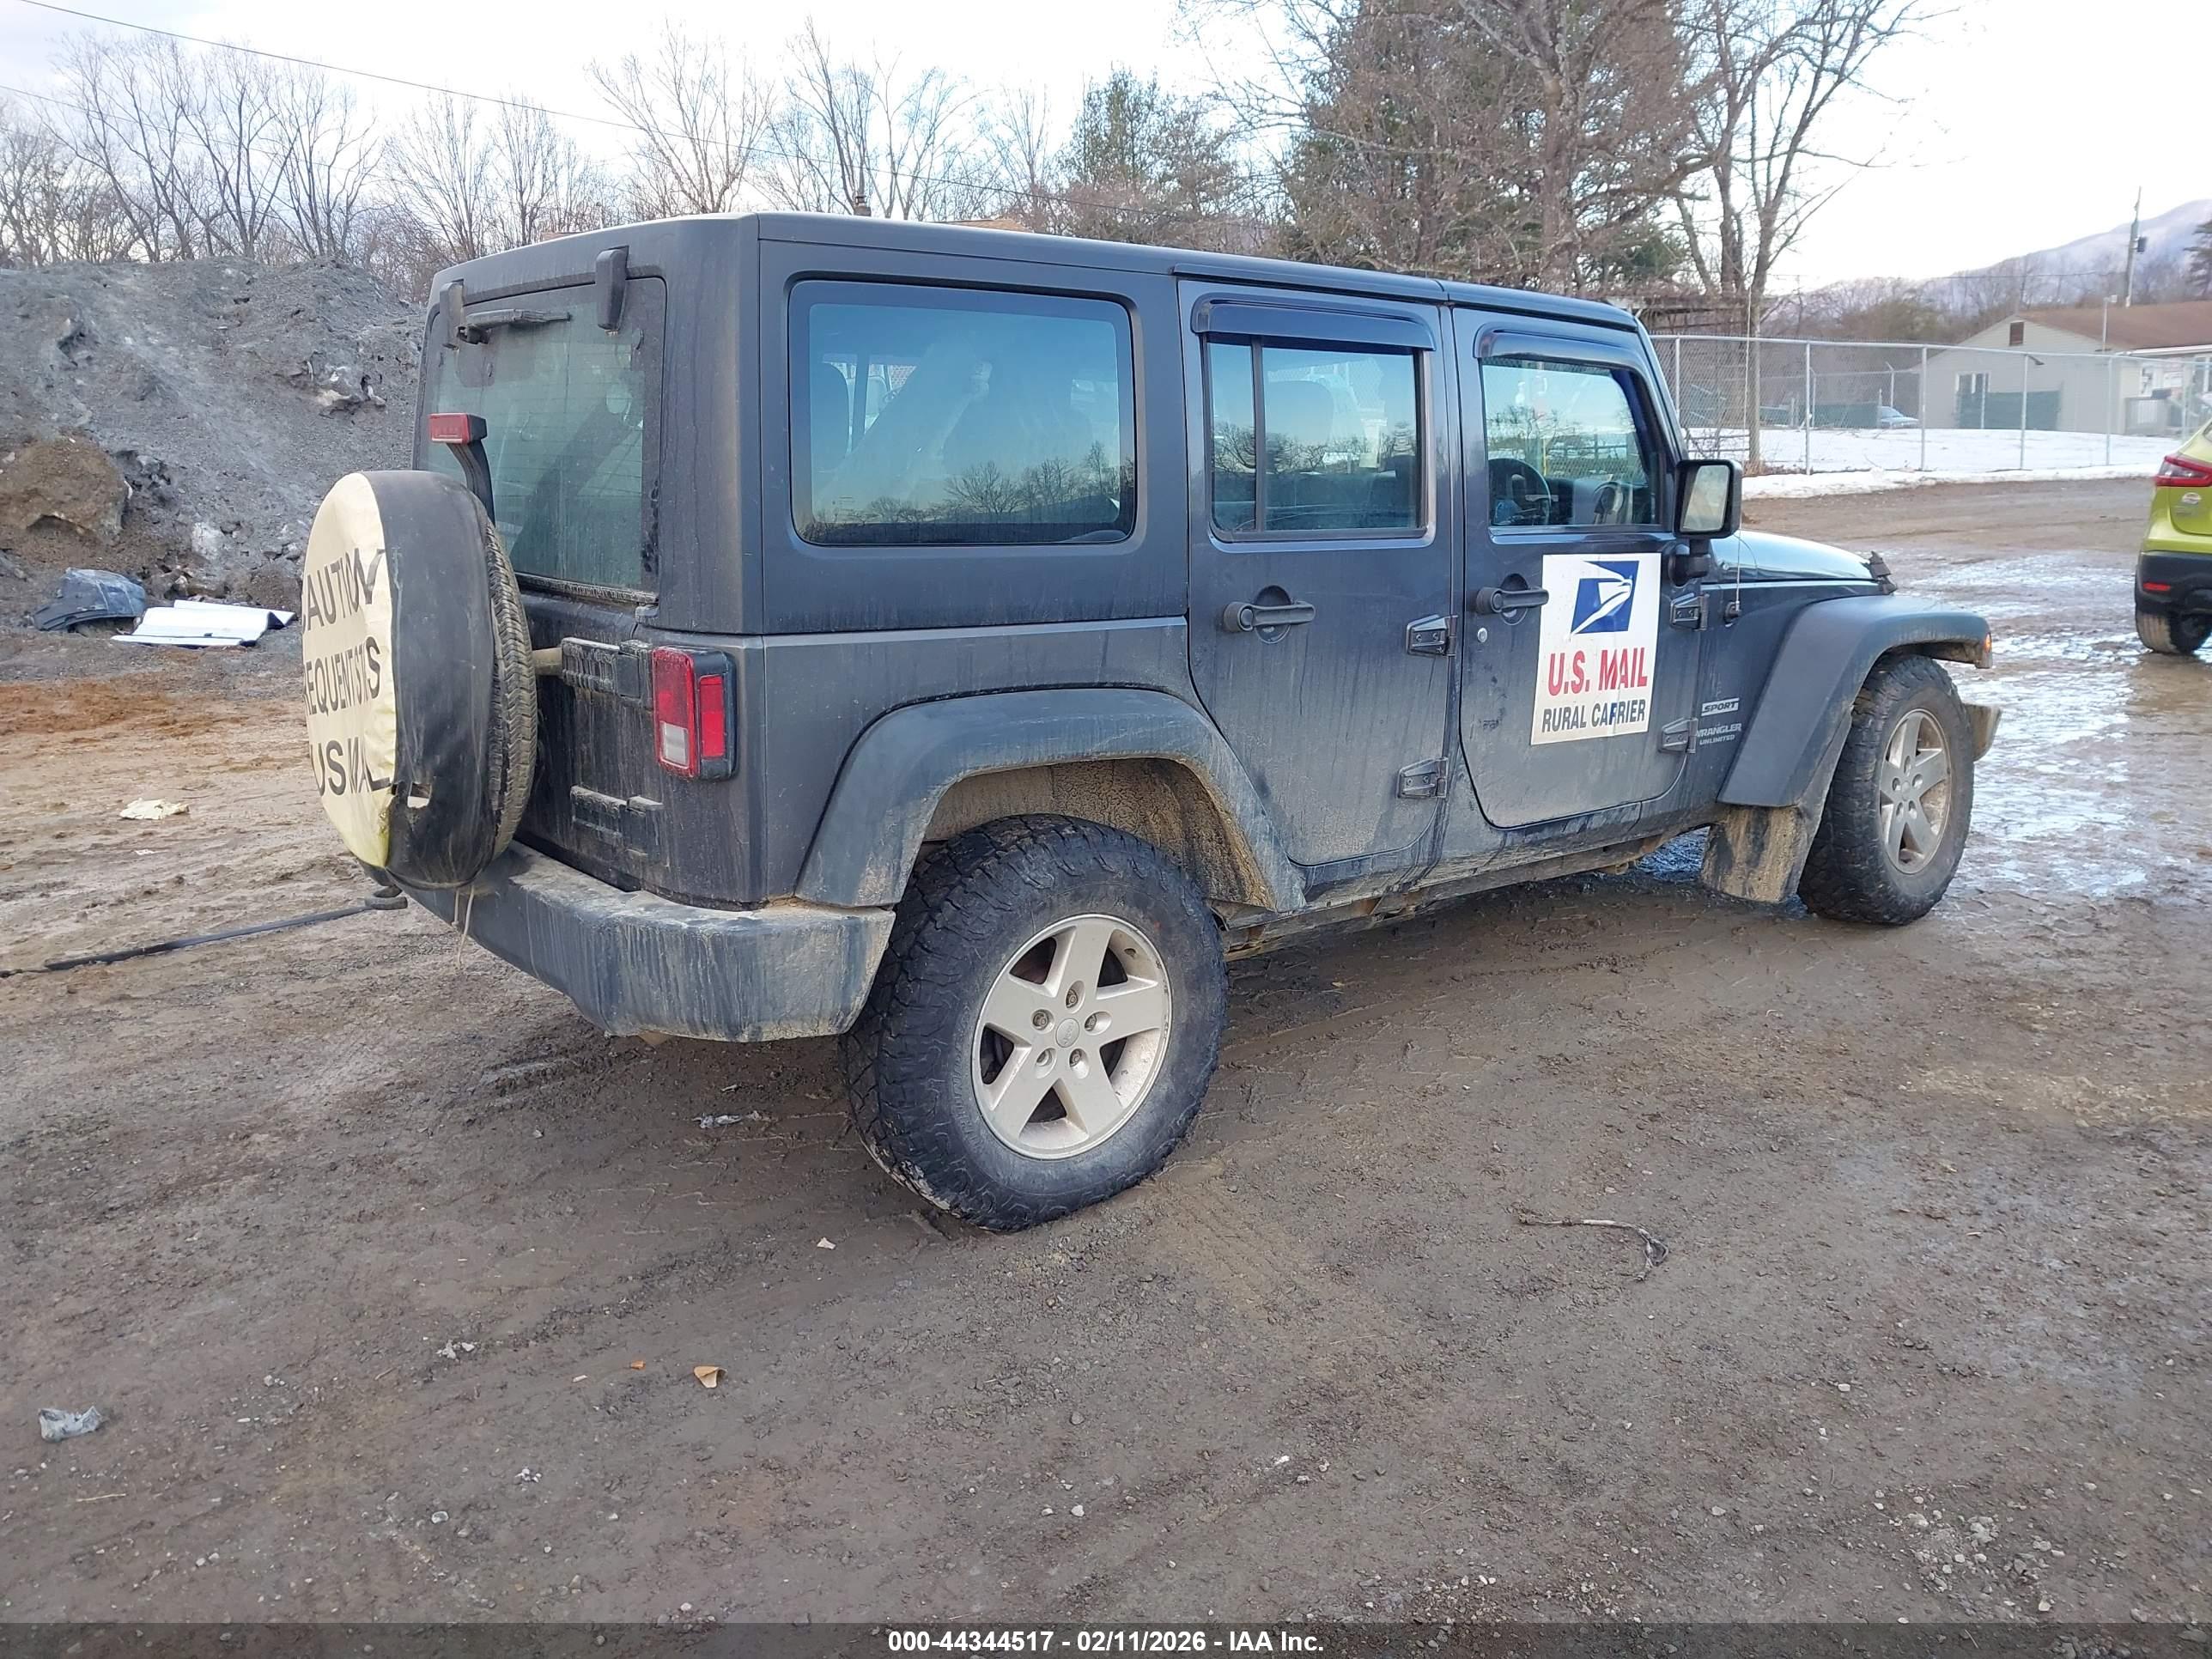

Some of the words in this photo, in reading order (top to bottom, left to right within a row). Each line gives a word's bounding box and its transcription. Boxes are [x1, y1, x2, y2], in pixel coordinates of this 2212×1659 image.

[302, 548, 386, 635] AUTION
[1547, 650, 1590, 696] U.S.
[1598, 647, 1648, 691] MAIL
[1541, 705, 1588, 733] RURAL
[1704, 702, 1736, 713] SPORT
[1699, 734, 1735, 745] UNLIMITED
